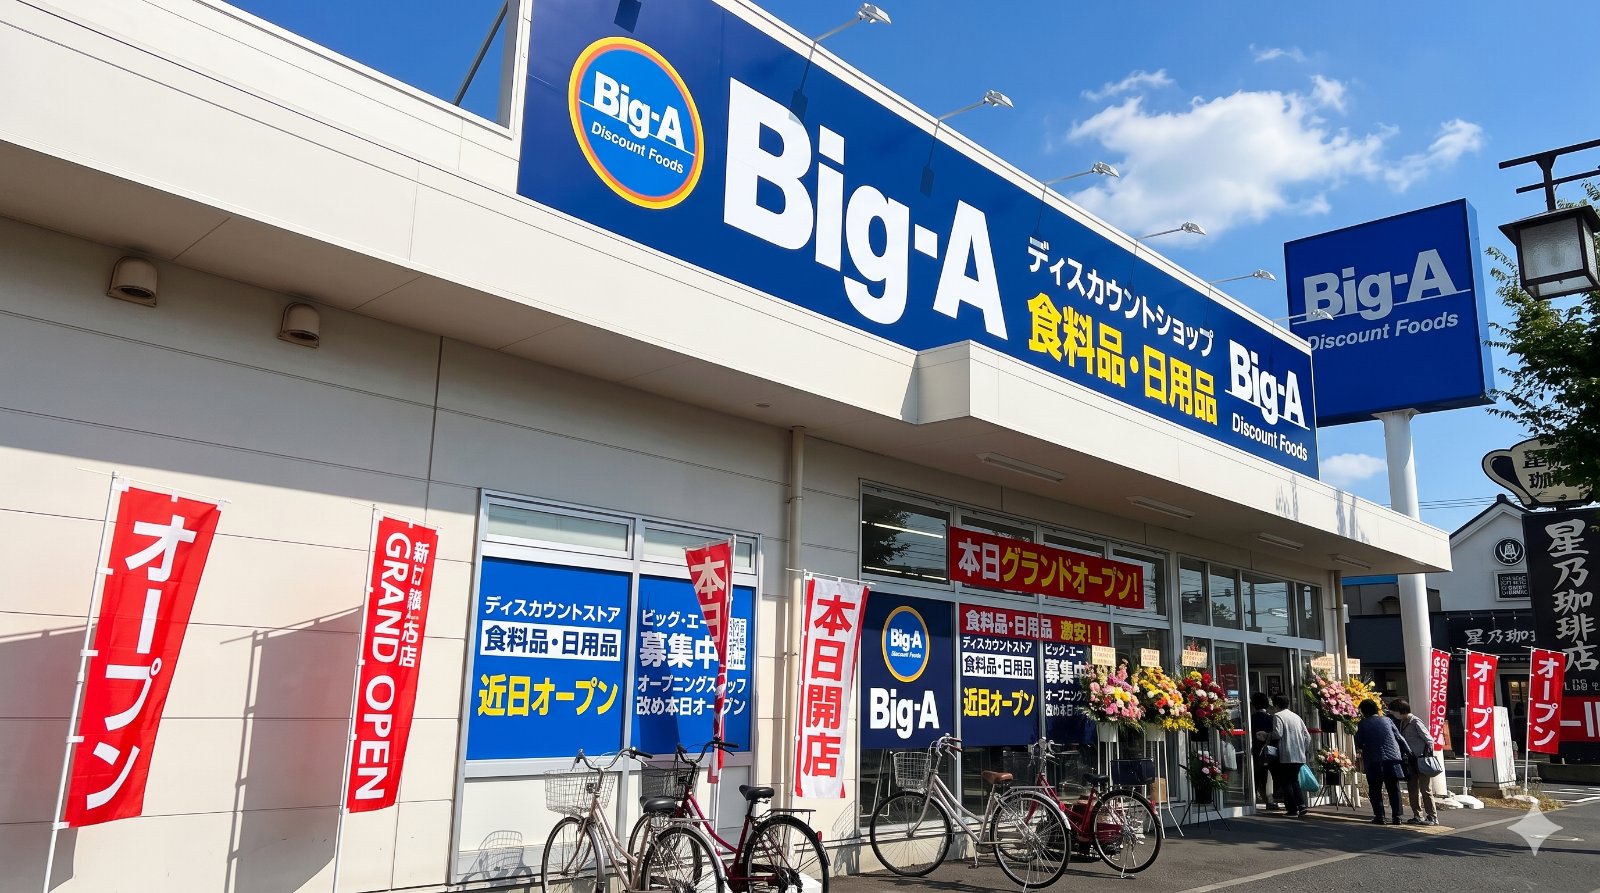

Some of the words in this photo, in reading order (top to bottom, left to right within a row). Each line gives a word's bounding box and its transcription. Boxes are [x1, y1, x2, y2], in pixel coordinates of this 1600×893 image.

[593, 70, 685, 151] Big-A
[591, 121, 646, 157] Discount
[648, 148, 684, 174] Foods
[723, 77, 1008, 340] Big-A
[1027, 236, 1214, 357] ディスカウントショップ
[1303, 248, 1457, 321] Big-A
[1307, 323, 1390, 351] Discount
[1395, 311, 1459, 337] Foods
[1027, 292, 1218, 426] 食料品・日用品
[1229, 339, 1306, 428] Big-A
[1232, 412, 1278, 449] Discount
[1279, 433, 1308, 461] Foods
[958, 537, 1138, 602] 本日グランドオープン!
[1545, 519, 1599, 672] 星乃珈琲店
[371, 532, 412, 664] GRAND
[485, 596, 621, 623] ディスカウントストア
[965, 609, 1053, 639] 食料品・日用品
[86, 514, 198, 811] オープン
[484, 624, 618, 658] 食料品・日用品
[639, 631, 719, 670] 募集中
[890, 628, 923, 652] Big-A
[962, 636, 1032, 654] ディスカウントストア
[964, 655, 1033, 677] 食料品・日用品
[1045, 643, 1084, 657] ビッグ・エー
[477, 673, 619, 717] 近日オープン
[637, 674, 746, 694] オープニングスッフ
[802, 594, 856, 778] 本日開店
[963, 687, 1035, 717] 近日オープン
[1472, 660, 1493, 752] オープン
[1533, 657, 1560, 746] オープン
[354, 675, 396, 801] OPEN
[870, 687, 940, 739] Big-A
